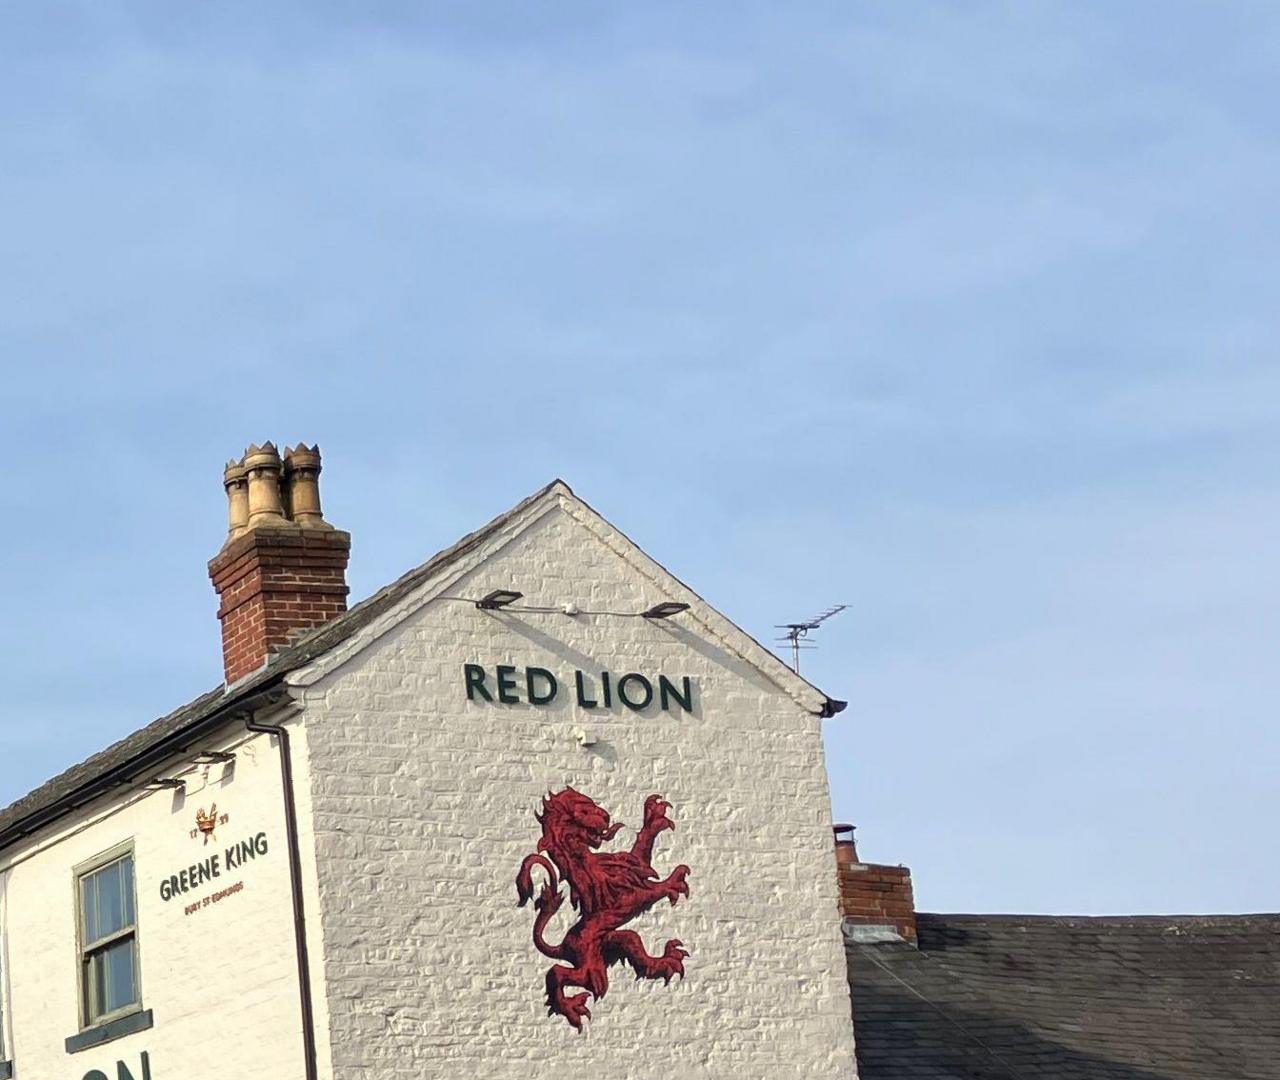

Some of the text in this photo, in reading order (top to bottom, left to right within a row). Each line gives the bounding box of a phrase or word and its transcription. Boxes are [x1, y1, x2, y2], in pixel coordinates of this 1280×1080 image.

[463, 663, 694, 713] RED LION
[159, 831, 268, 902] GREENE KING
